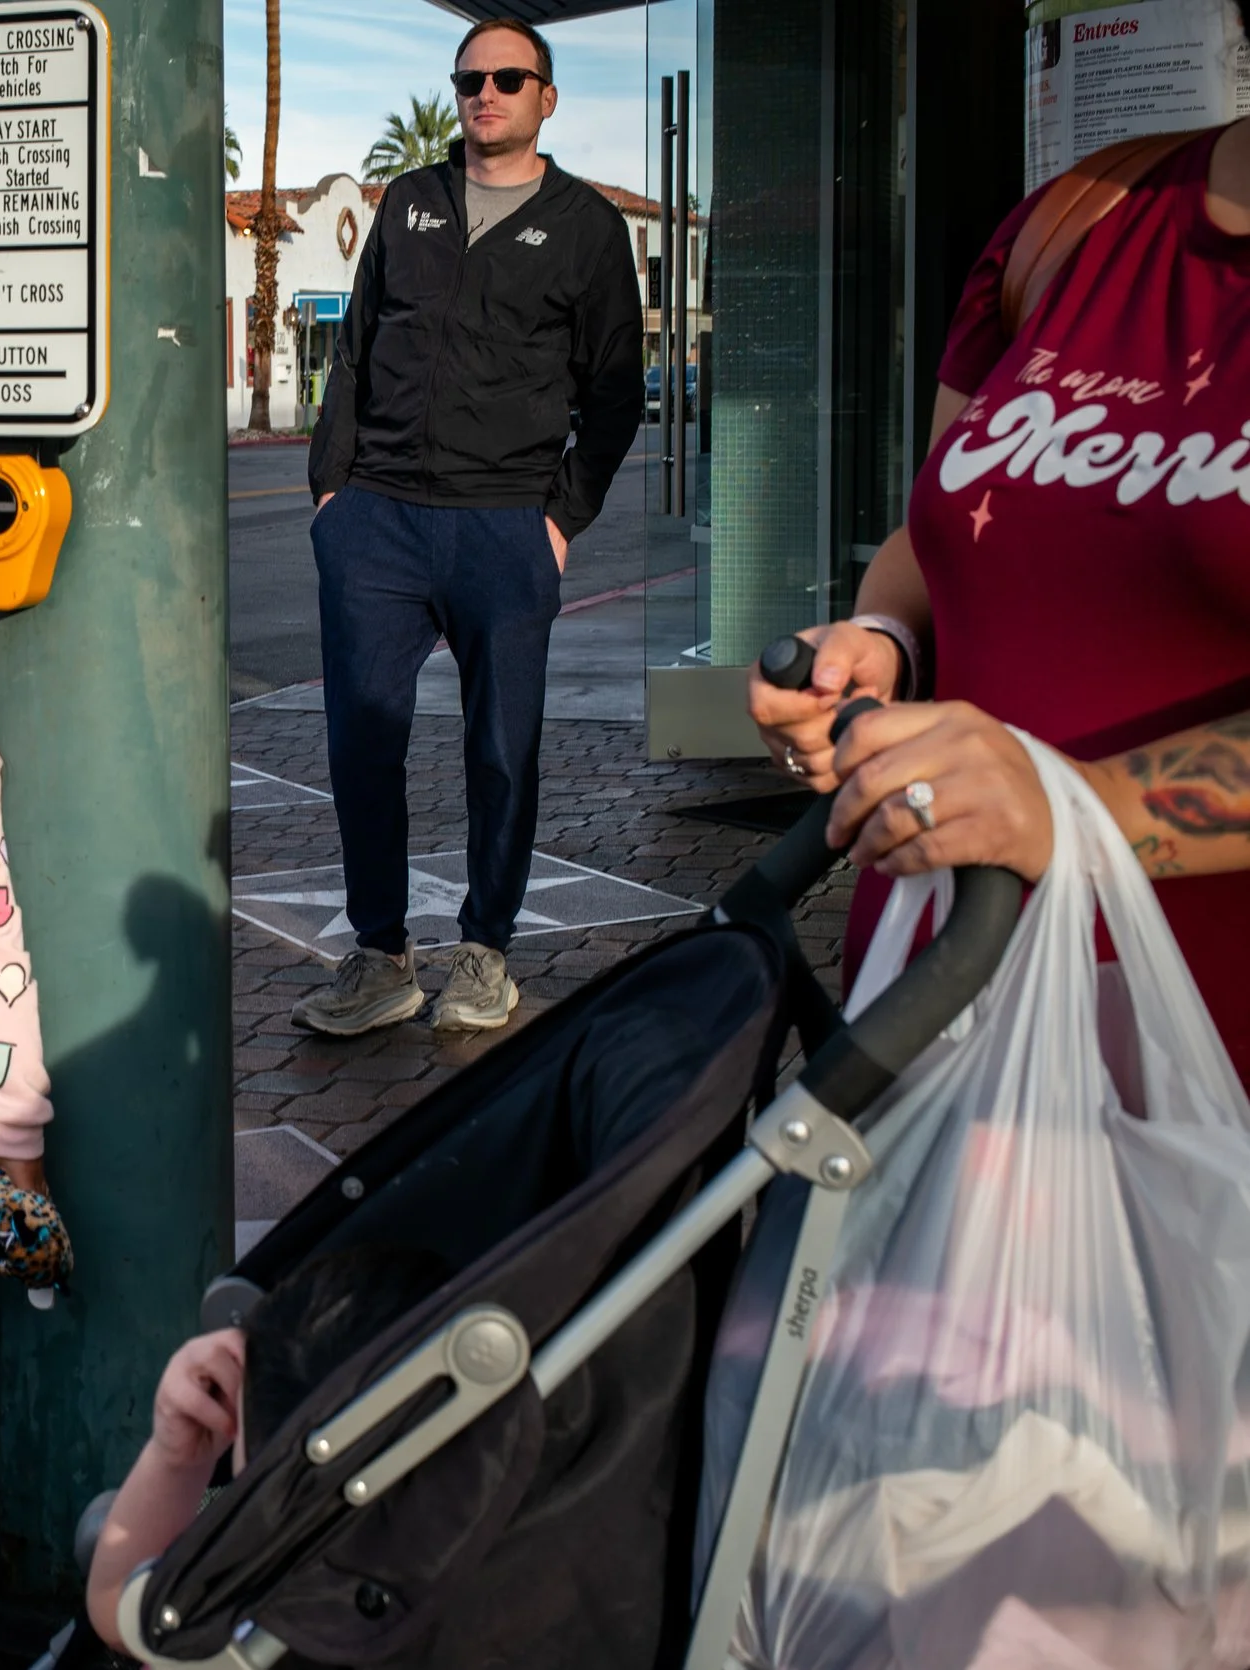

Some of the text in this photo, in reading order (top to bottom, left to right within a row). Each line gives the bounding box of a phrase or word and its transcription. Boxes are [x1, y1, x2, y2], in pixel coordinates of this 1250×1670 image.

[6, 27, 75, 50] CROSSING
[1072, 16, 1140, 44] Entrées
[27, 55, 48, 75] For
[17, 119, 57, 139] START
[17, 145, 71, 168] Crossing
[5, 168, 50, 187] Started
[3, 191, 80, 212] REMAINING
[28, 215, 81, 239] Crossing
[20, 283, 64, 303] CROSS
[939, 390, 1250, 507] Merri
[784, 1266, 819, 1341] sherpa
